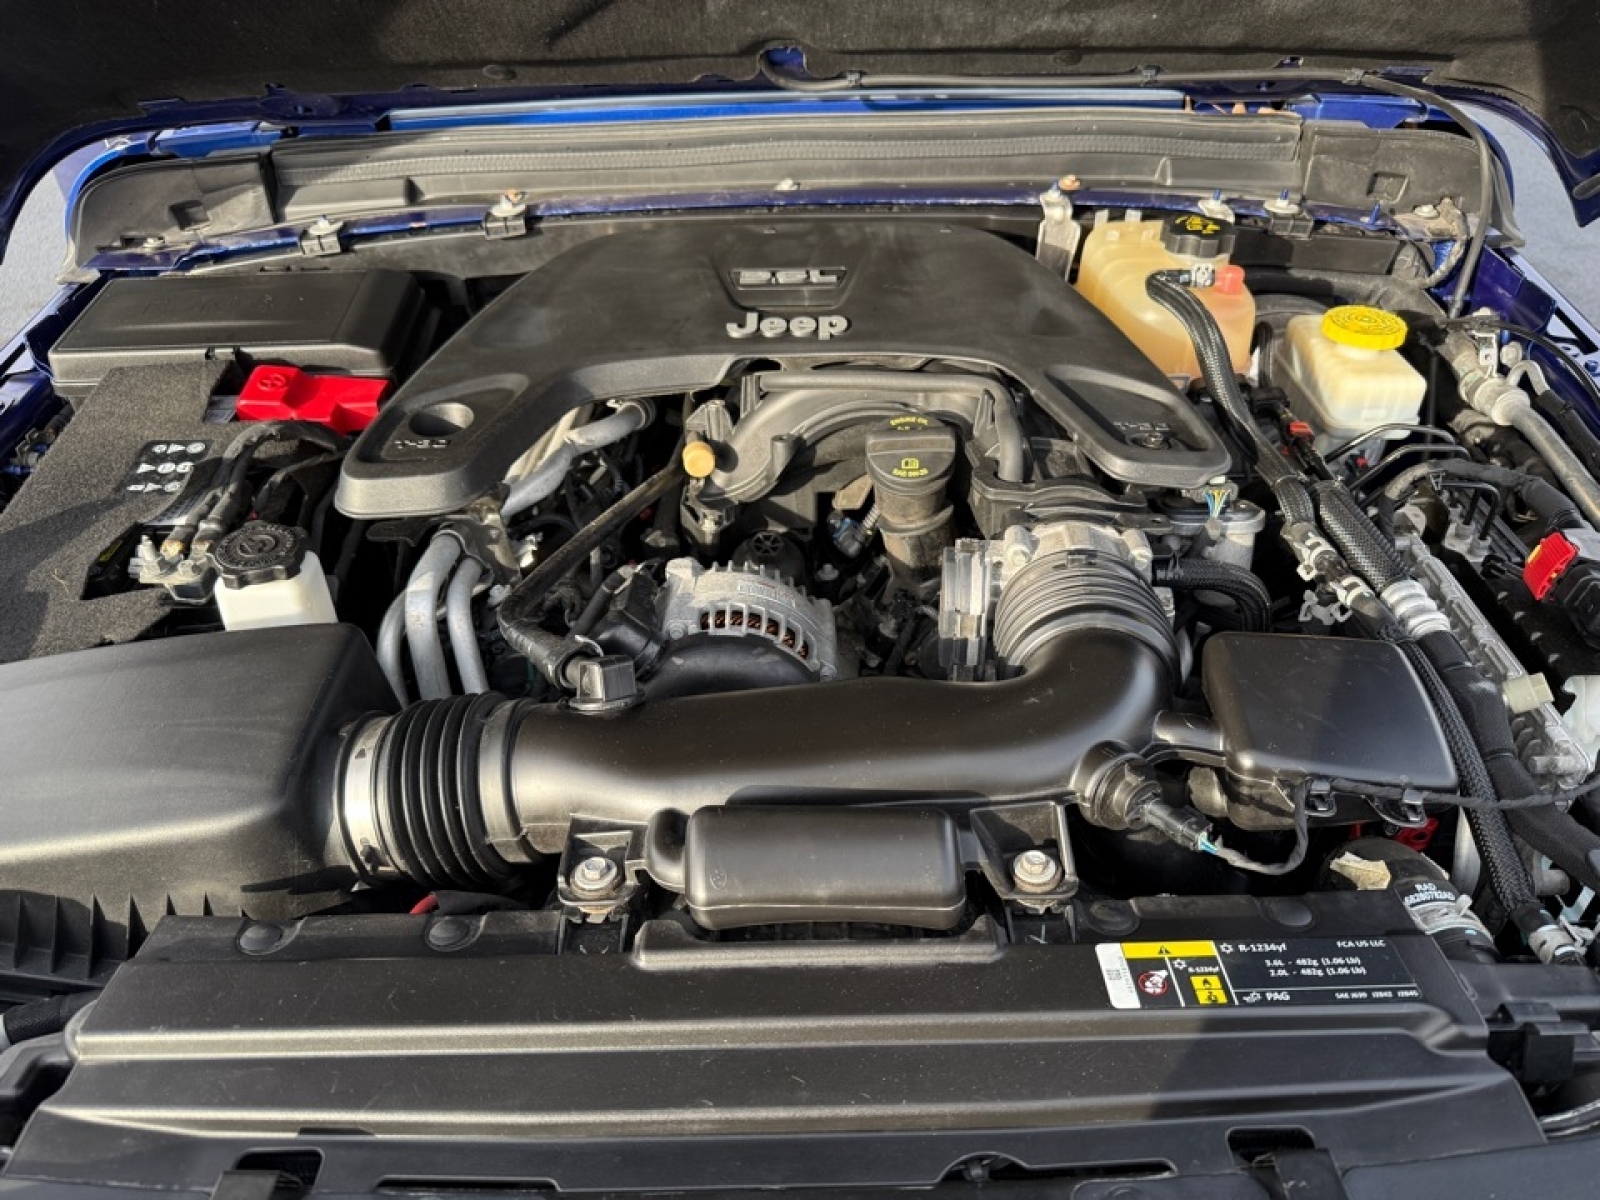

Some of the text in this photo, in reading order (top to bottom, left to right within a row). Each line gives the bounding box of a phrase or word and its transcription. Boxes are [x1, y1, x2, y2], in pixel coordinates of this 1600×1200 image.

[726, 312, 849, 341] Jeep
[1336, 939, 1355, 948] FCA
[1355, 939, 1369, 948] US
[1265, 991, 1290, 1001] PAG
